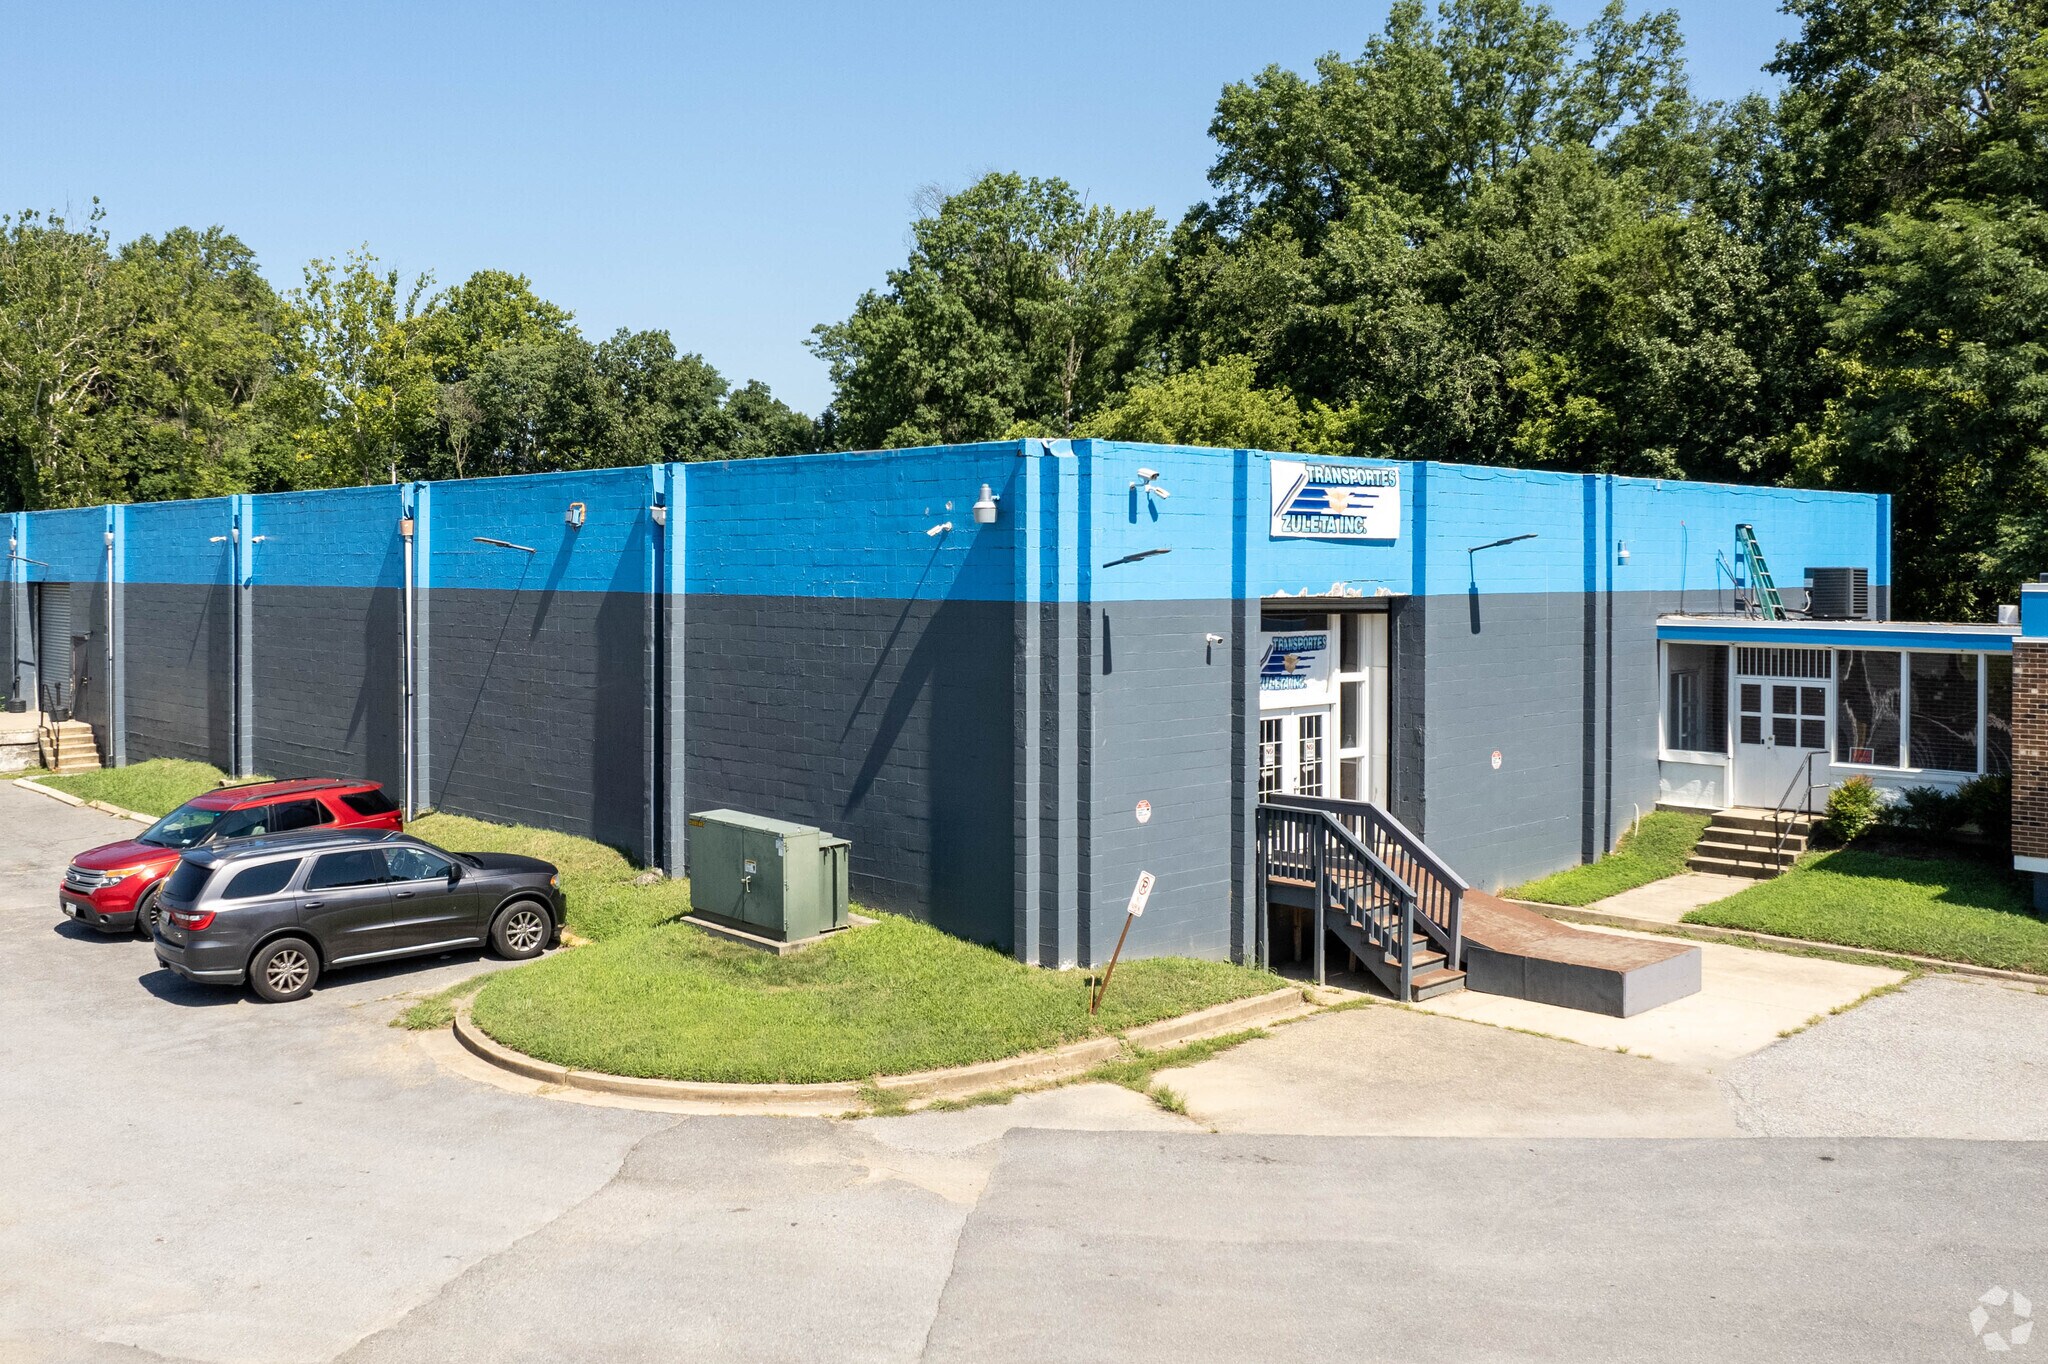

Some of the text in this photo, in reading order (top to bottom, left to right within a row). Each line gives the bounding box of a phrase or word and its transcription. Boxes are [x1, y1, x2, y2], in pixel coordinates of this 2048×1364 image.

[1305, 465, 1397, 487] TRANSPORTES
[1281, 514, 1367, 534] ZULETA INC.
[1272, 634, 1327, 652] TRANSPORTES
[1260, 676, 1289, 690] ULETA
